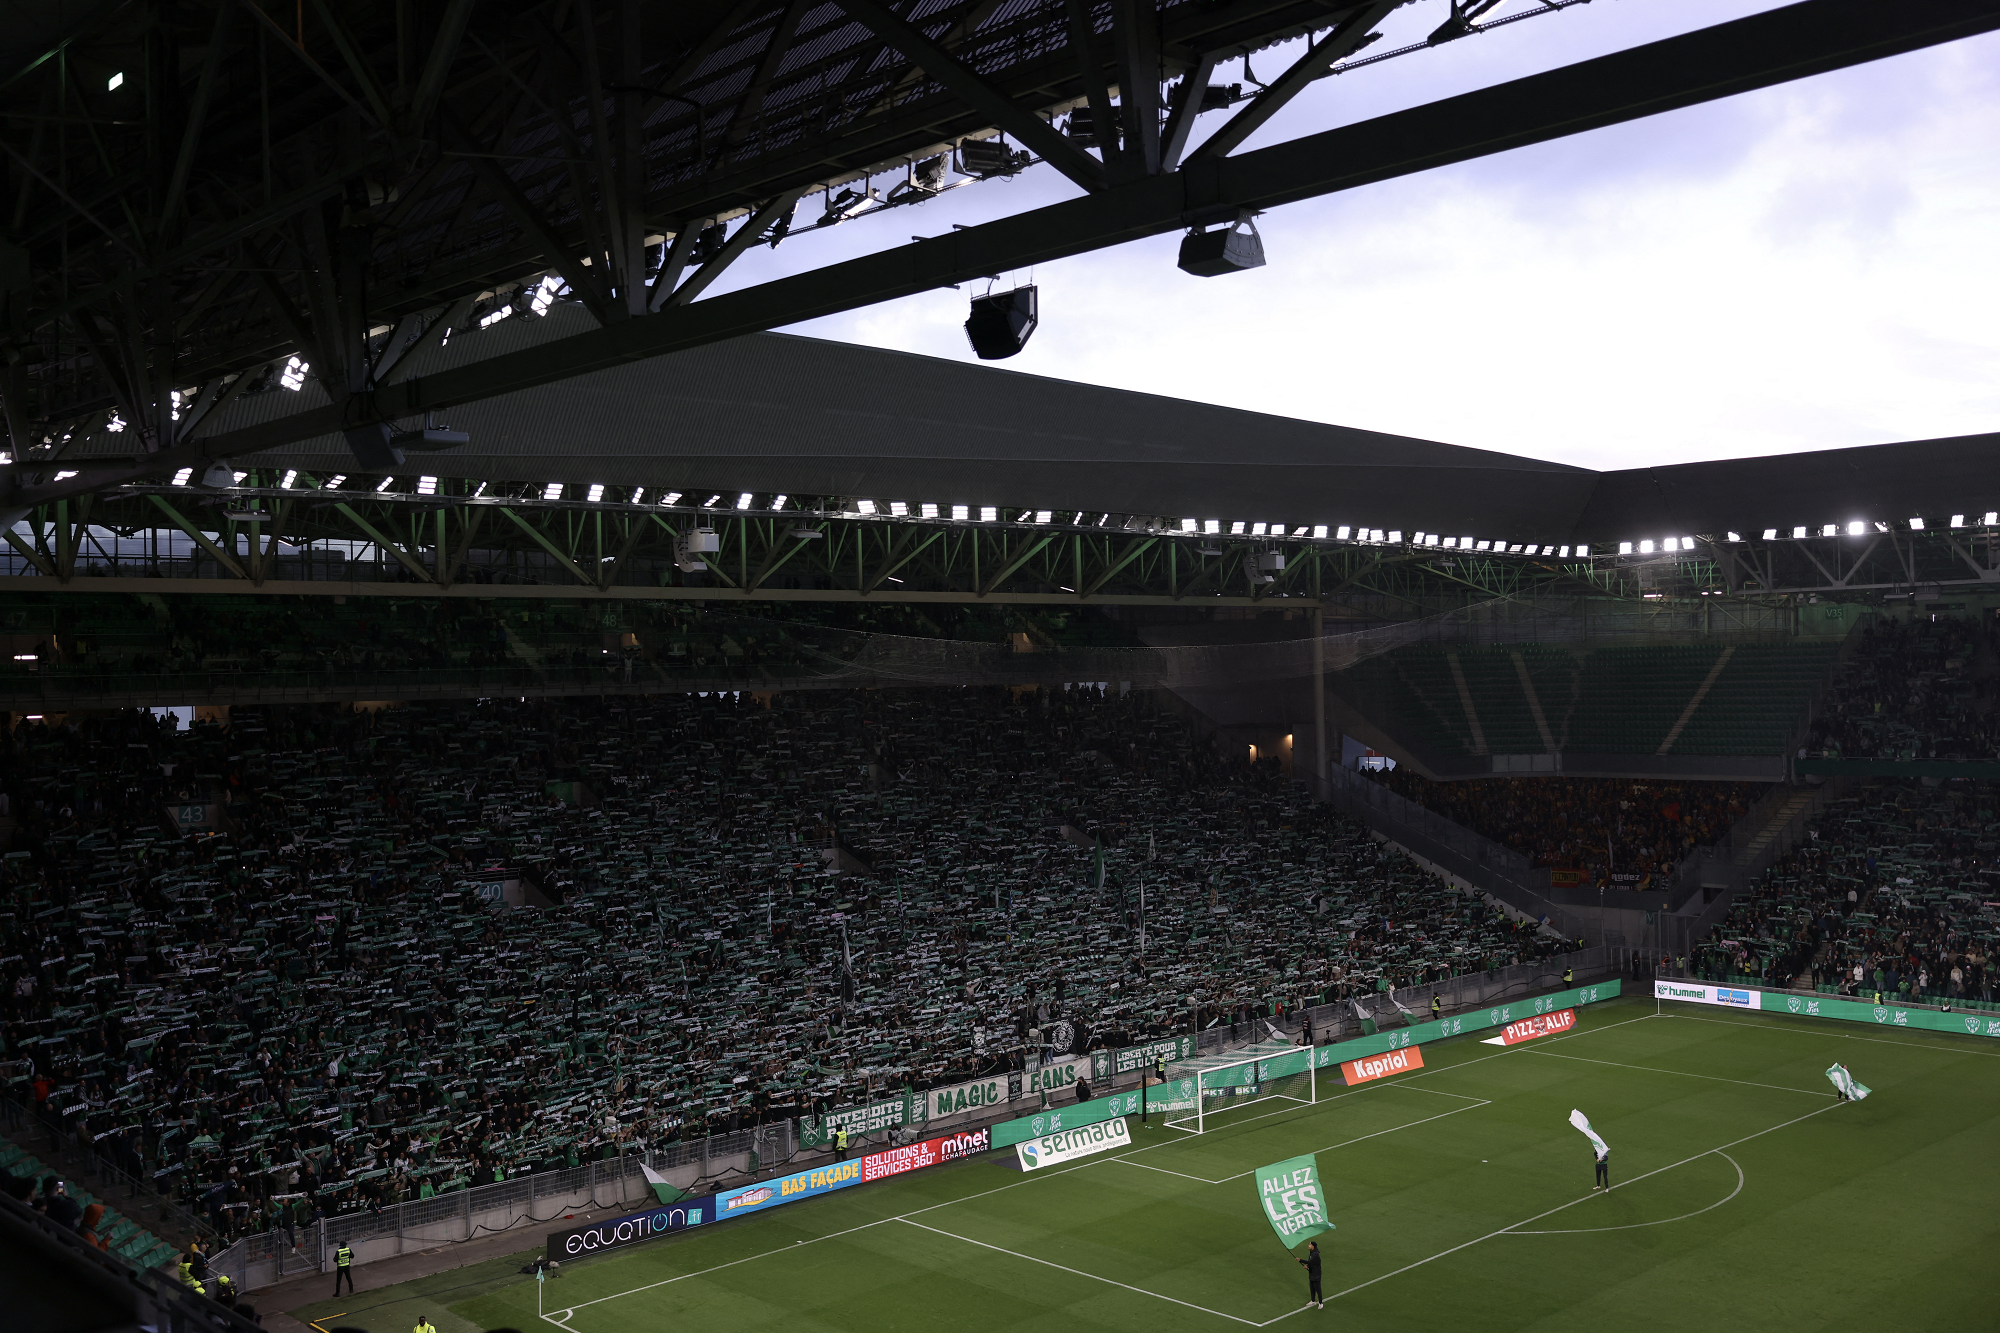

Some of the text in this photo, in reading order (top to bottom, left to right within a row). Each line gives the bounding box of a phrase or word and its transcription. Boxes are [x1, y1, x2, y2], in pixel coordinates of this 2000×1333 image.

[602, 614, 617, 627] 48
[1826, 608, 1843, 618] V35
[181, 806, 204, 823] 43
[480, 884, 501, 901] 40
[1669, 986, 1706, 999] hummel
[1506, 1011, 1571, 1039] PIZZ ALIF
[1153, 1041, 1177, 1055] POUR
[1117, 1052, 1177, 1073] LES ULTAS
[1353, 1049, 1408, 1078] Kapriol
[1030, 1064, 1076, 1094] FANS
[1235, 1086, 1257, 1094] BKT
[937, 1081, 998, 1115] MAGIC
[1157, 1099, 1195, 1112] hummel
[826, 1100, 904, 1128] INTERDITS
[826, 1112, 903, 1140] PÉSENTS
[1041, 1119, 1125, 1157] sermaco
[865, 1142, 929, 1169] SOLUTIONS &
[941, 1145, 988, 1161] ECHAFAUDAGE
[781, 1162, 859, 1197] BAS FAÇADE
[865, 1158, 912, 1181] SERVICES
[1263, 1167, 1314, 1196] ALLEZ
[1264, 1185, 1320, 1221] LES
